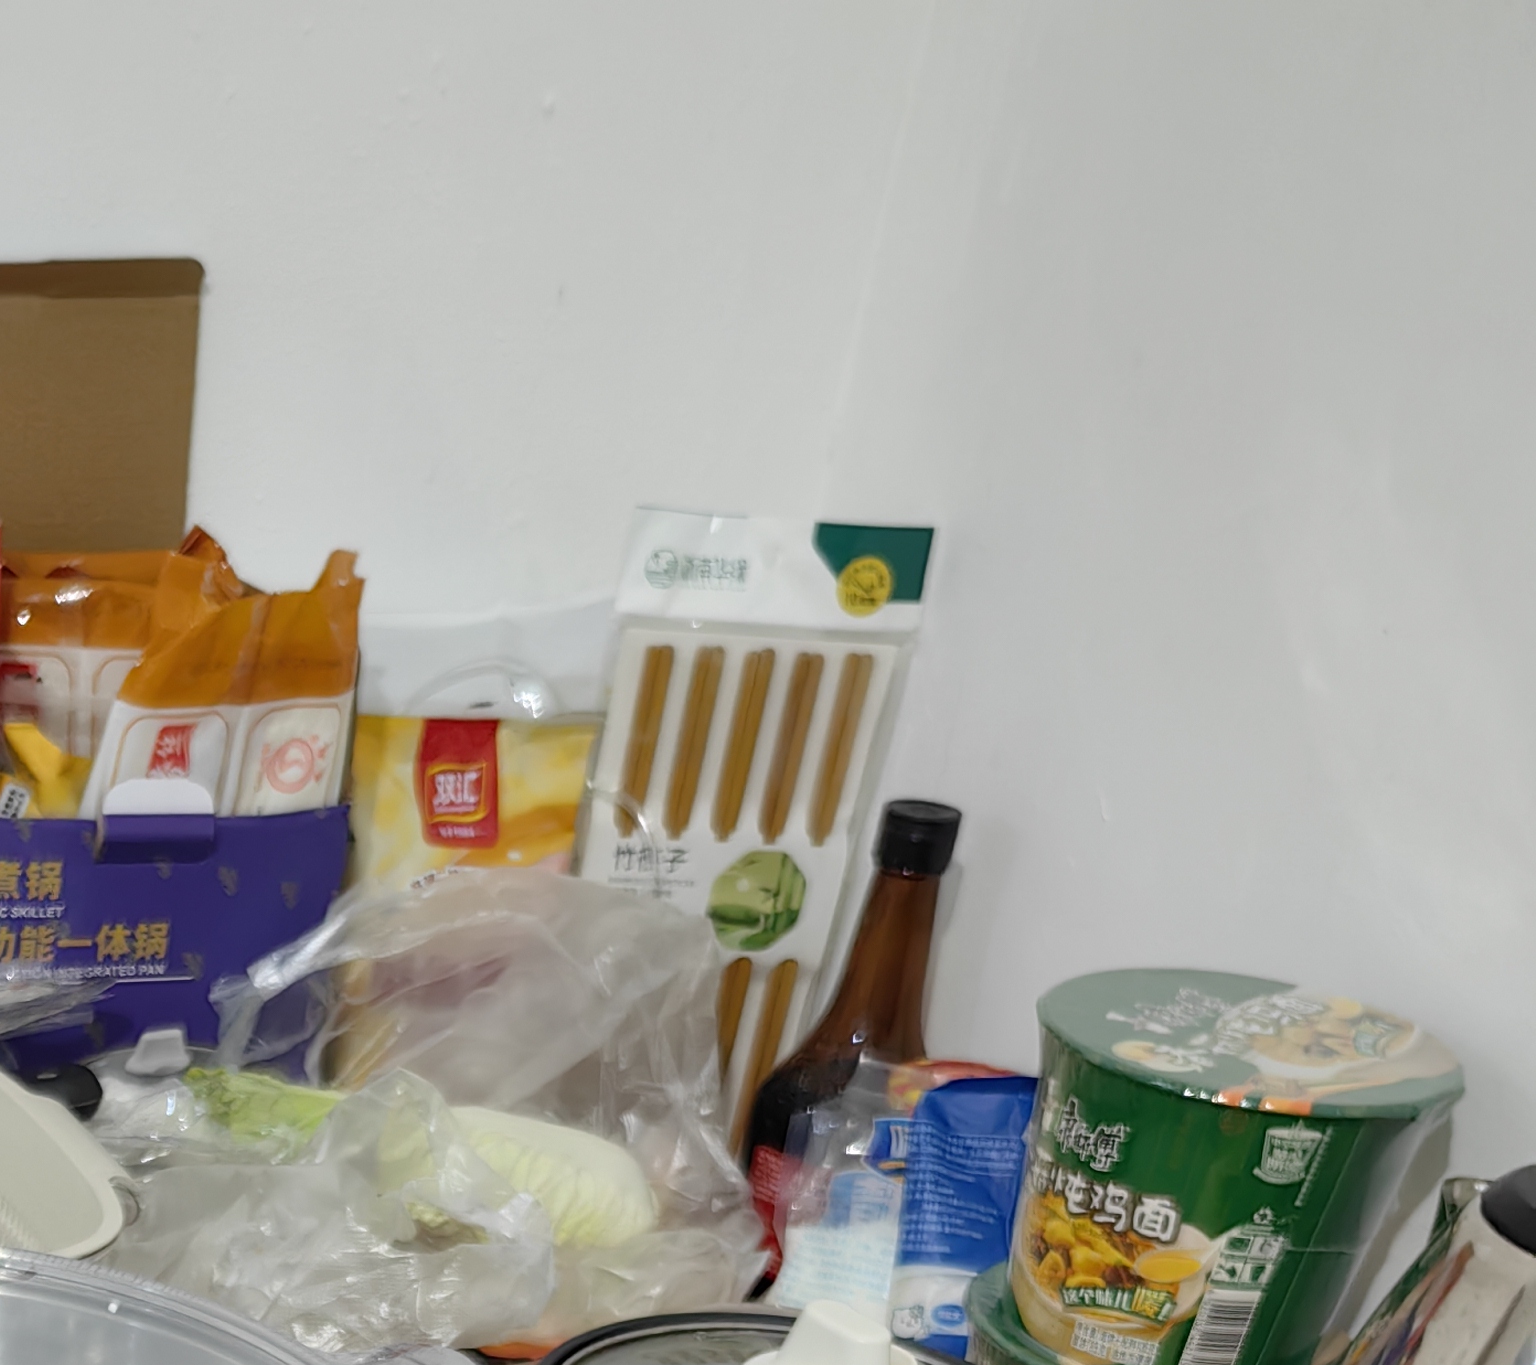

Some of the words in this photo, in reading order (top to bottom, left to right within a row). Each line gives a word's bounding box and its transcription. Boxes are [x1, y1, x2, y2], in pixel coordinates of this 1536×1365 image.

[432, 771, 482, 806] 双汇
[10, 902, 66, 919] SKILLET
[137, 963, 166, 976] PAN
